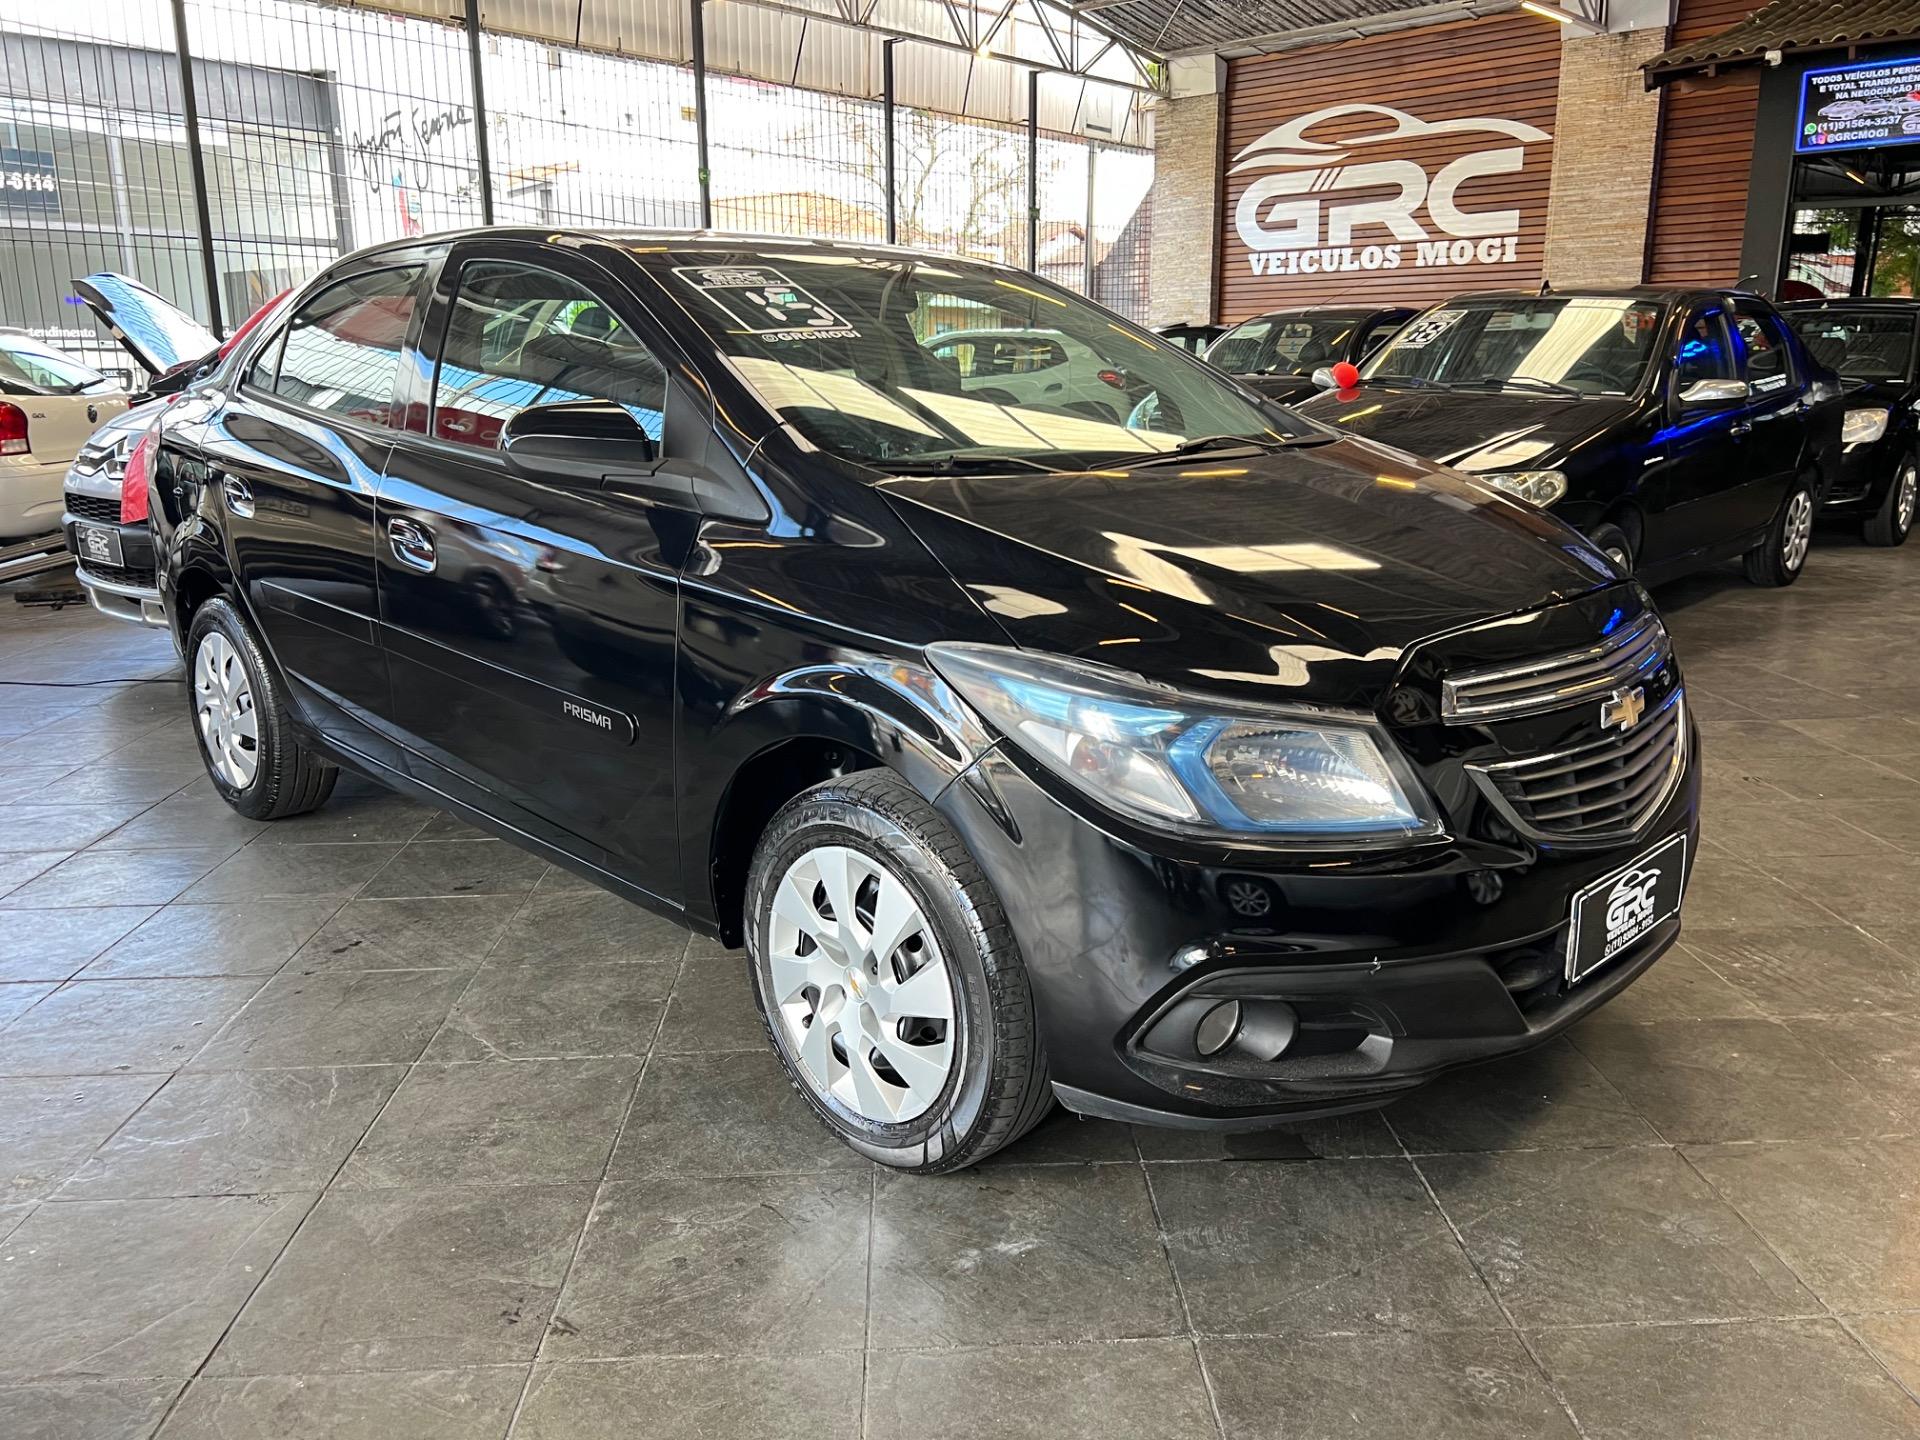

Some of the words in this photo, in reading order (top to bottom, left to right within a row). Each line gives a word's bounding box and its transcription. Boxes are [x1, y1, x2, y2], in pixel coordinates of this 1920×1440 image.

[1811, 74, 1842, 85] TODOS
[1844, 69, 1891, 81] VEÍCULOS
[1819, 85, 1827, 93] E
[1828, 82, 1857, 92] TOTAL
[1835, 92, 1849, 100] NA
[1850, 84, 1913, 98] NEGOCIAÇÃO
[1827, 128, 1889, 143] @GRCMOGI
[1235, 147, 1524, 250] GRC
[1248, 245, 1401, 276] VEICULOS
[1416, 236, 1519, 268] MOGI
[28, 326, 96, 338] tendimento
[761, 330, 862, 343] @GRCMOGI
[563, 700, 612, 731] PRISMA
[1606, 875, 1657, 931] GRC
